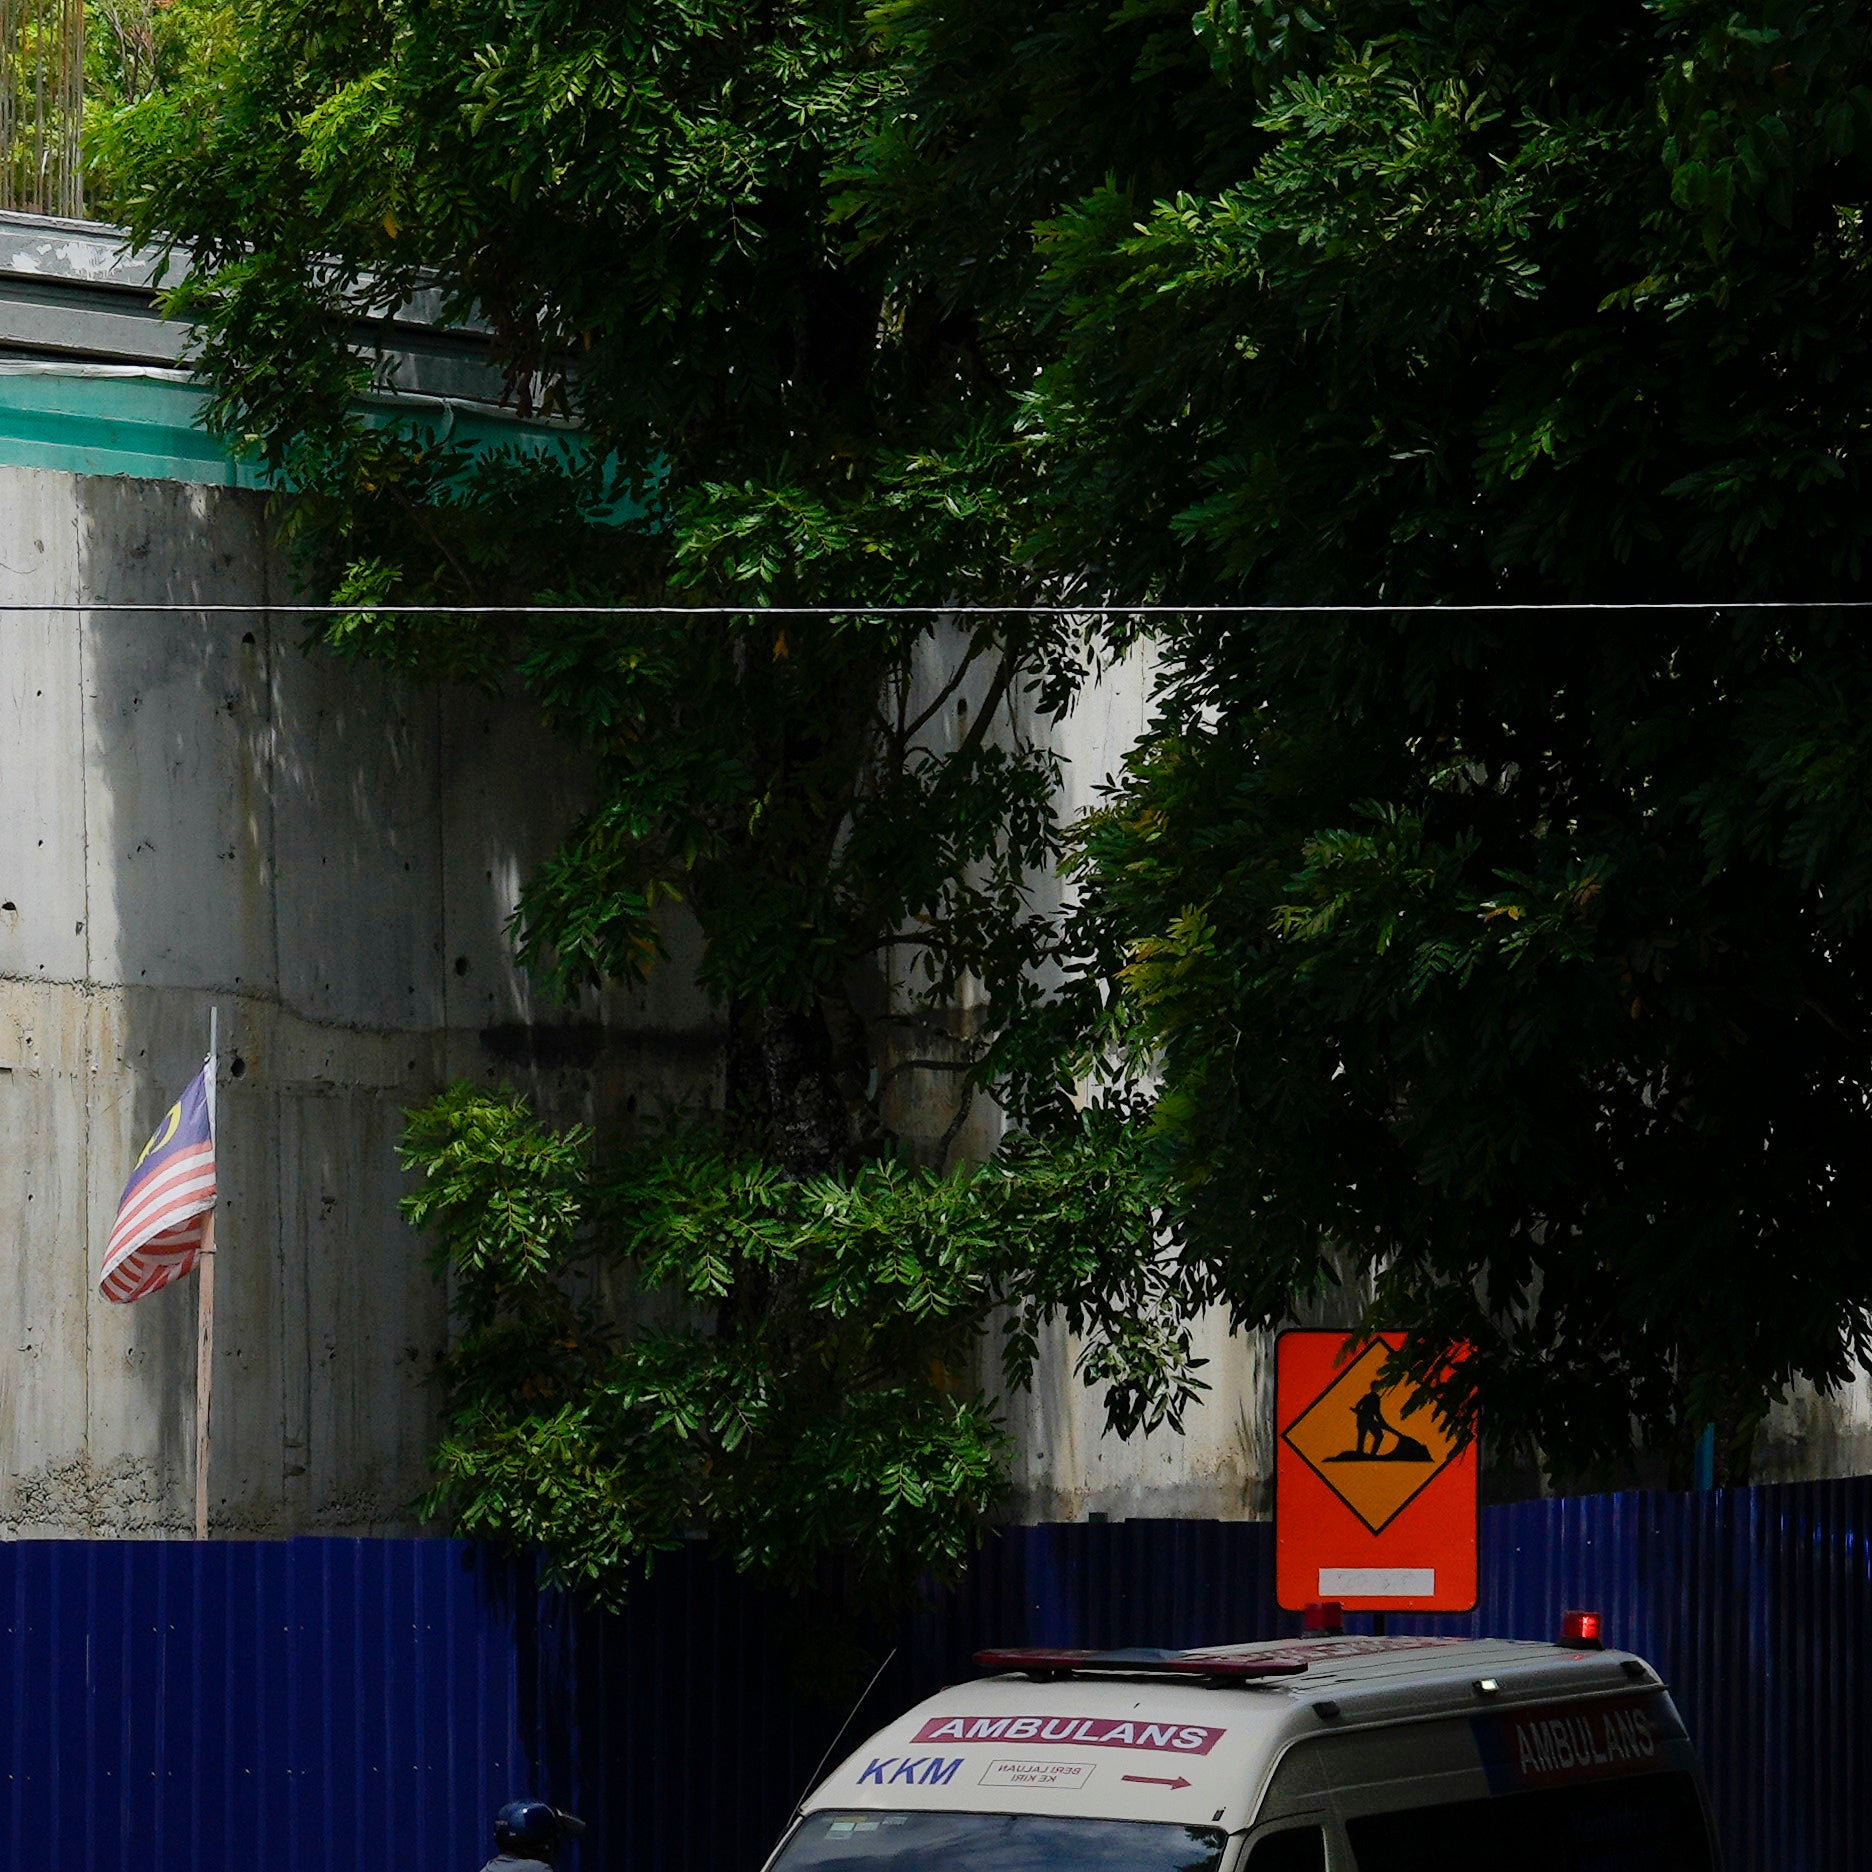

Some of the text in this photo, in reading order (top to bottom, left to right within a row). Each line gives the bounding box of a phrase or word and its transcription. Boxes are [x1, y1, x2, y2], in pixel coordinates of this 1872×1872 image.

[930, 1717, 1209, 1751] AMBULANS
[1515, 1708, 1655, 1774] AMBULANS
[856, 1757, 965, 1786] KKM
